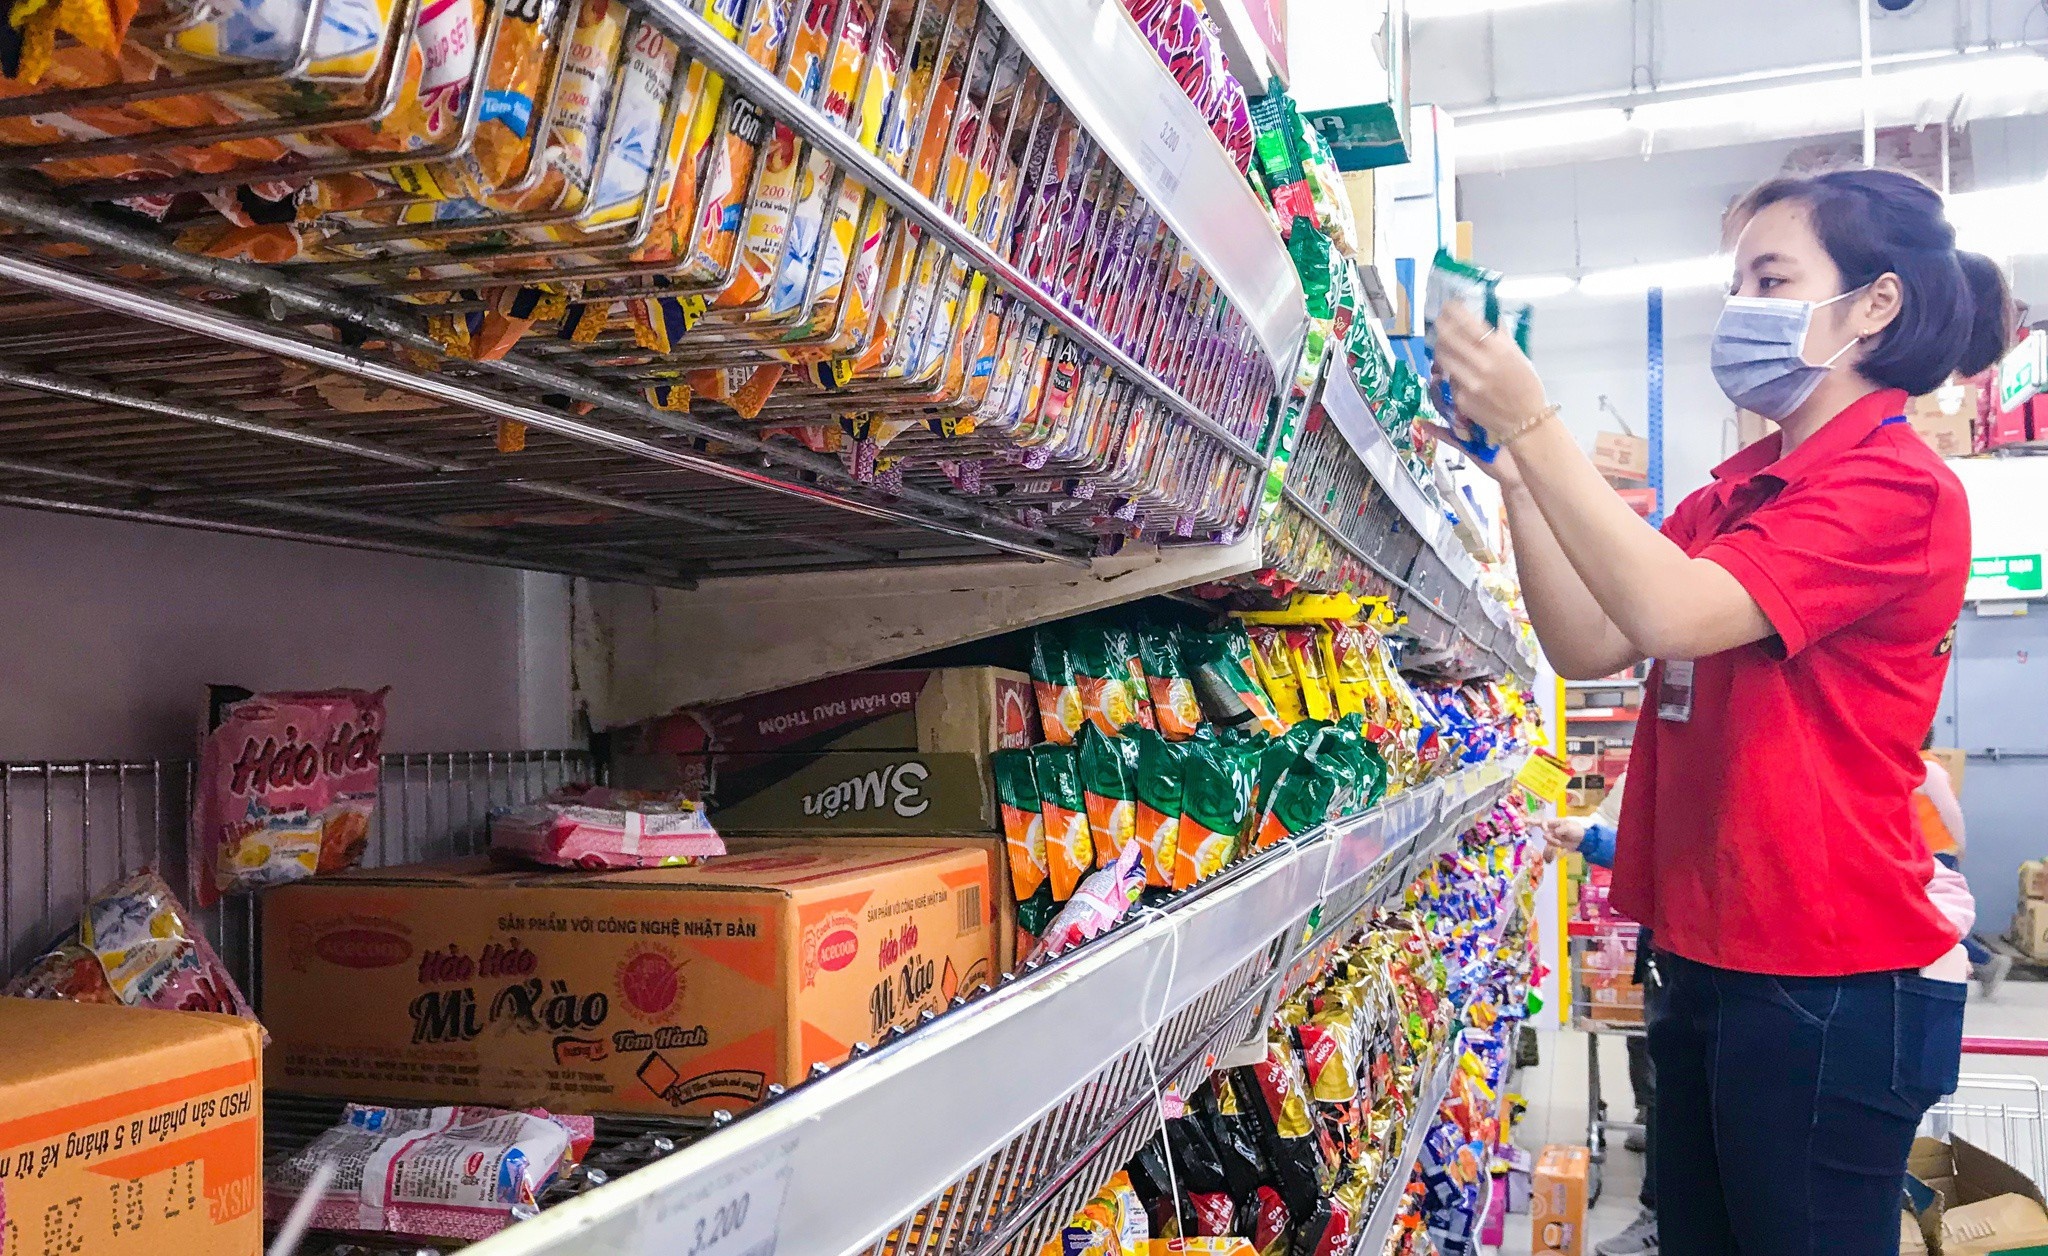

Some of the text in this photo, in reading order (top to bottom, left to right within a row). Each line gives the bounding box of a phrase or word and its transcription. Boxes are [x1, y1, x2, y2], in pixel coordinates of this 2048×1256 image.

[1160, 120, 1180, 152] 3.200
[760, 184, 785, 199] 200
[813, 700, 846, 720] RAU
[229, 724, 319, 795] Hảo
[803, 761, 930, 820] 3 Miền
[498, 913, 524, 932] SẢN
[529, 911, 566, 932] PHẨM
[597, 916, 636, 934] CÔNG
[640, 917, 680, 938] NGHỆ
[684, 918, 722, 938] NHẬT
[726, 917, 756, 937] BẢN
[409, 988, 484, 1043] Mì
[490, 978, 608, 1032] Xào
[869, 976, 896, 1038] Mì
[898, 954, 934, 1014] Xào
[192, 1100, 216, 1128] sản
[220, 1083, 252, 1118] (HSD
[114, 1125, 125, 1149] 5
[131, 1119, 144, 1146] là
[149, 1102, 188, 1142] phẩm
[66, 1129, 110, 1160] tháng
[38, 1145, 59, 1179] kể
[688, 1192, 750, 1256] 3.200
[1268, 1206, 1282, 1220] GIA
